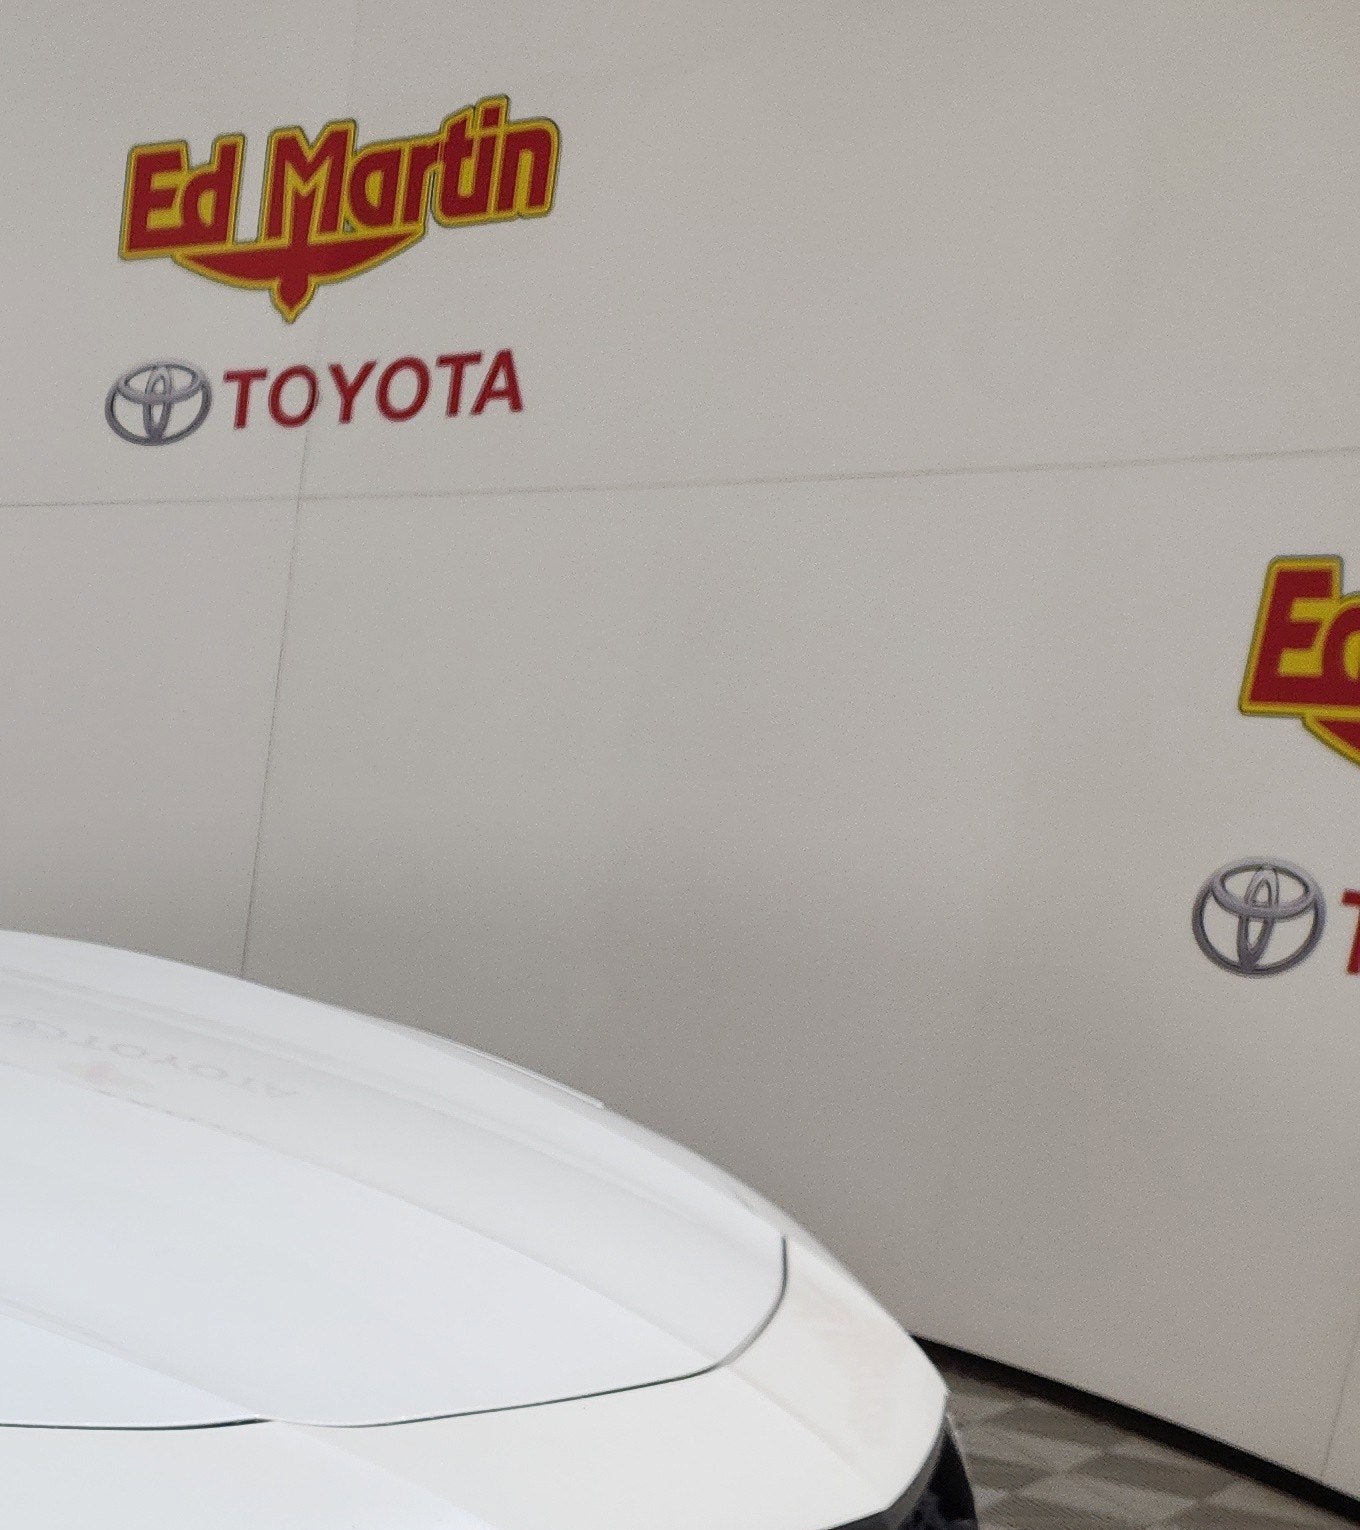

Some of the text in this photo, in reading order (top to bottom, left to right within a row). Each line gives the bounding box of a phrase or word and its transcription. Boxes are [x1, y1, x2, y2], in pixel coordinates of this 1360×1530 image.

[122, 98, 558, 256] Ed Martin
[224, 348, 523, 430] TOYOTA
